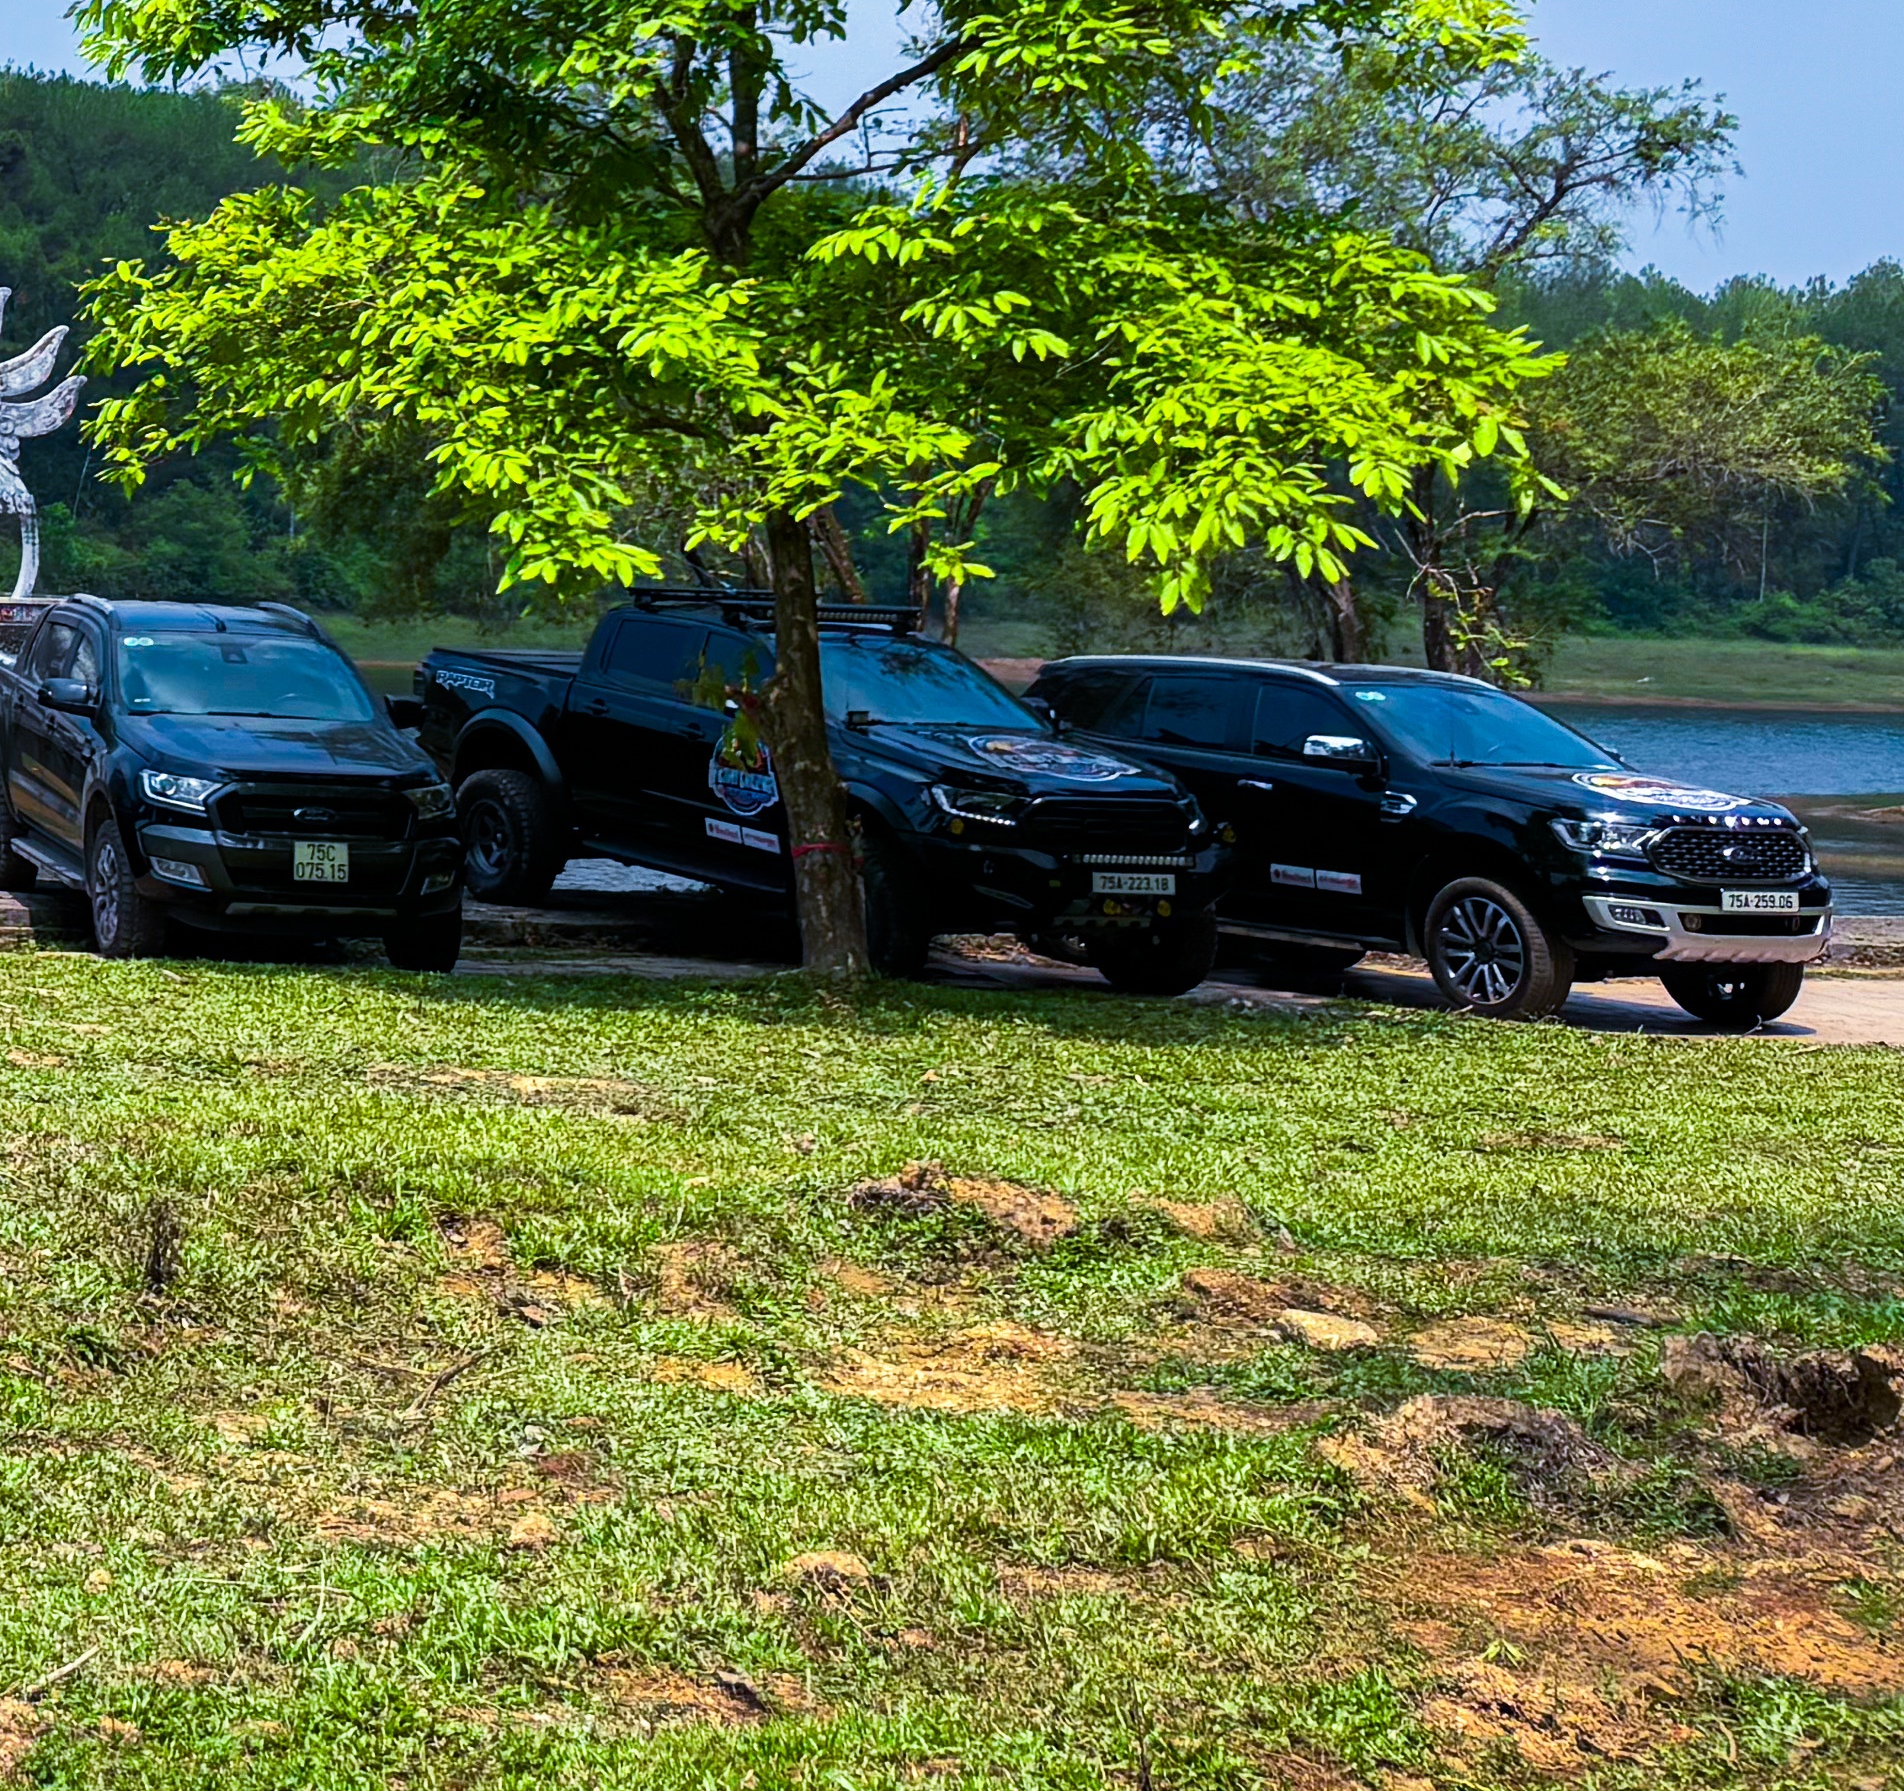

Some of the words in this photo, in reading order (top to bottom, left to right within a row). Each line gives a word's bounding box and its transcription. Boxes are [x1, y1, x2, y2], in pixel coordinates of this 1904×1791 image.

[435, 669, 495, 700] RAPTOR
[306, 843, 336, 862] 75C
[295, 861, 348, 881] 075.15
[1728, 893, 1794, 909] 75A-259.06
